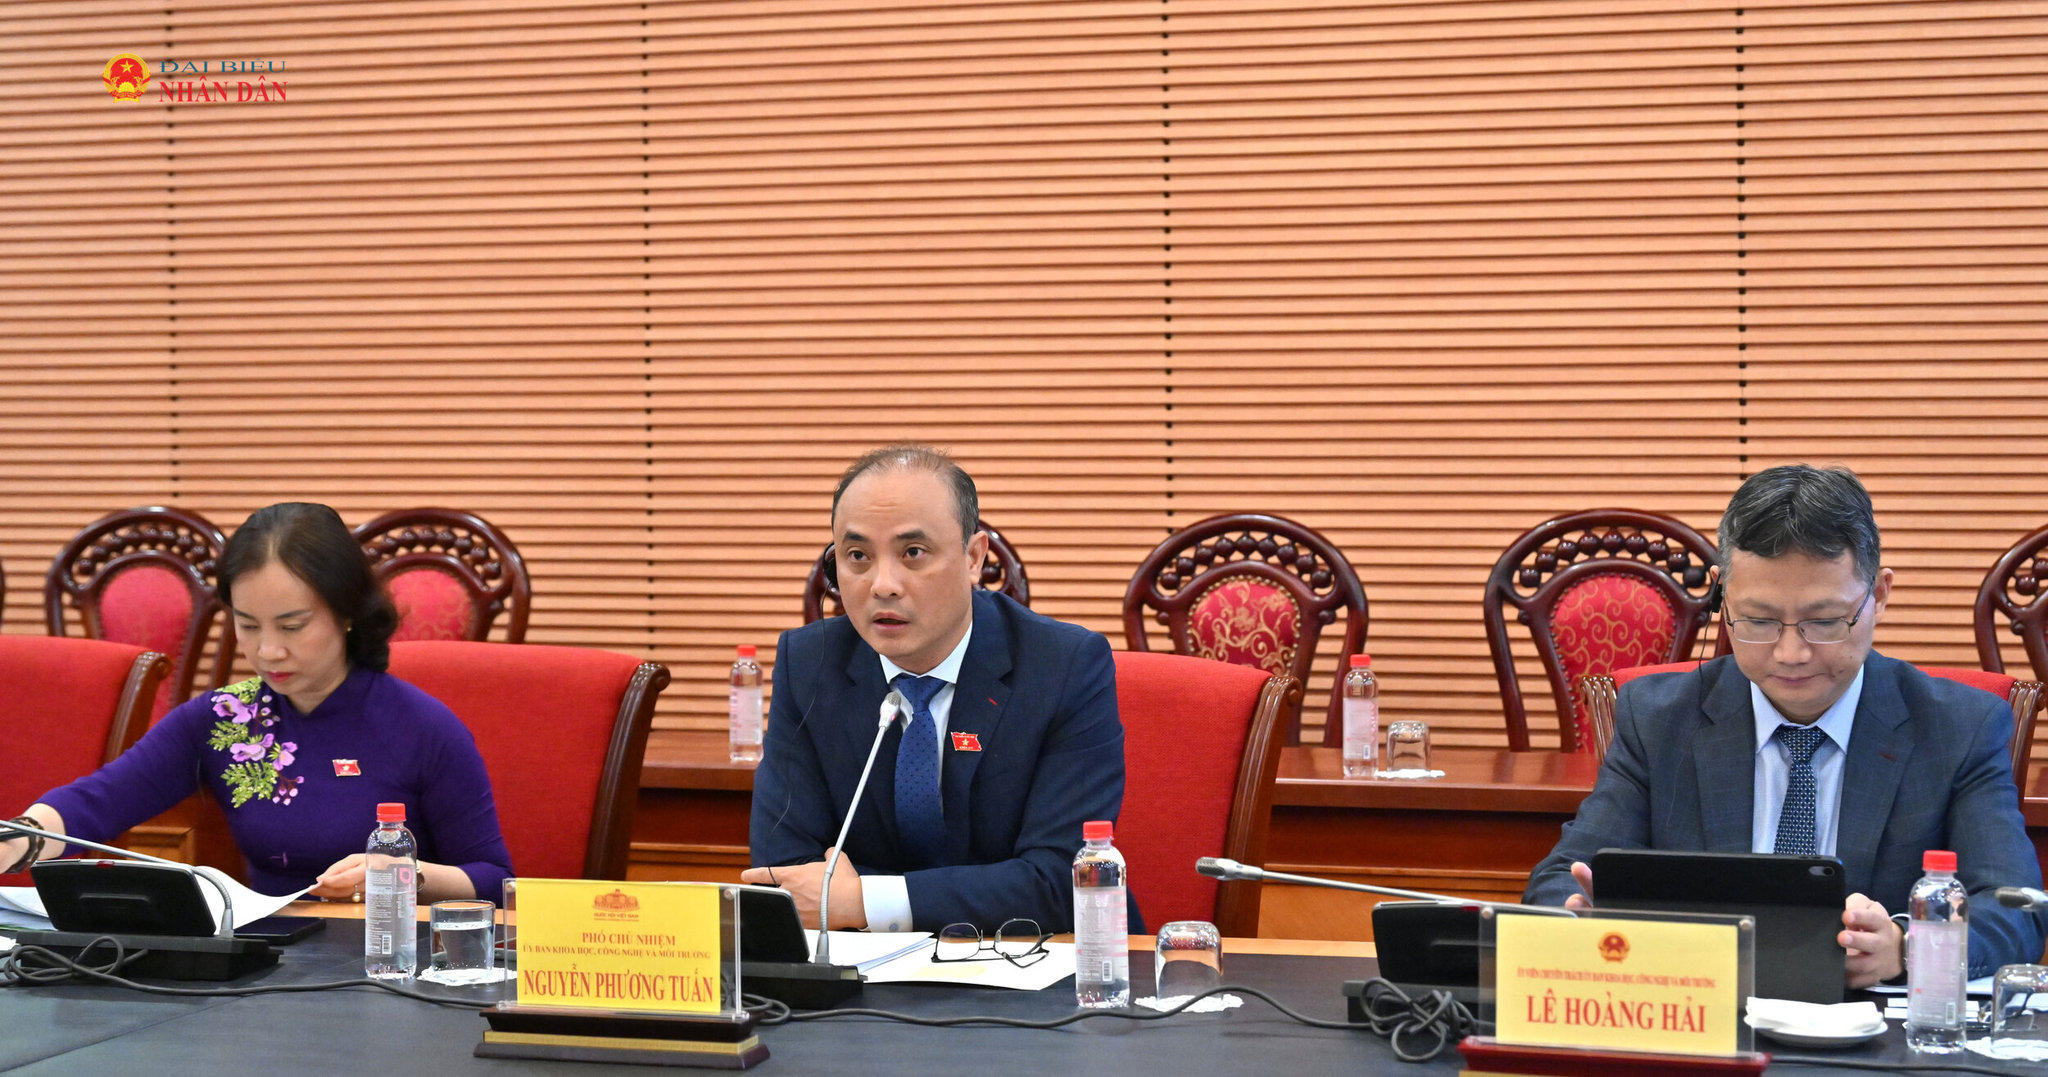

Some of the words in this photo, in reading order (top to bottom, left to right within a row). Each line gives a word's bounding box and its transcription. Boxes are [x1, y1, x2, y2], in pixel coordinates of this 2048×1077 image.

[582, 929, 606, 943] PHÓ
[636, 933, 675, 948] NHIỆM
[524, 963, 590, 998] NGUYỄN
[595, 969, 664, 1000] PHƯƠNG
[668, 968, 713, 1003] TUẤN
[1526, 988, 1557, 1024] LÊ
[1564, 992, 1654, 1030] HOÀNG
[1661, 996, 1706, 1033] HẢI
